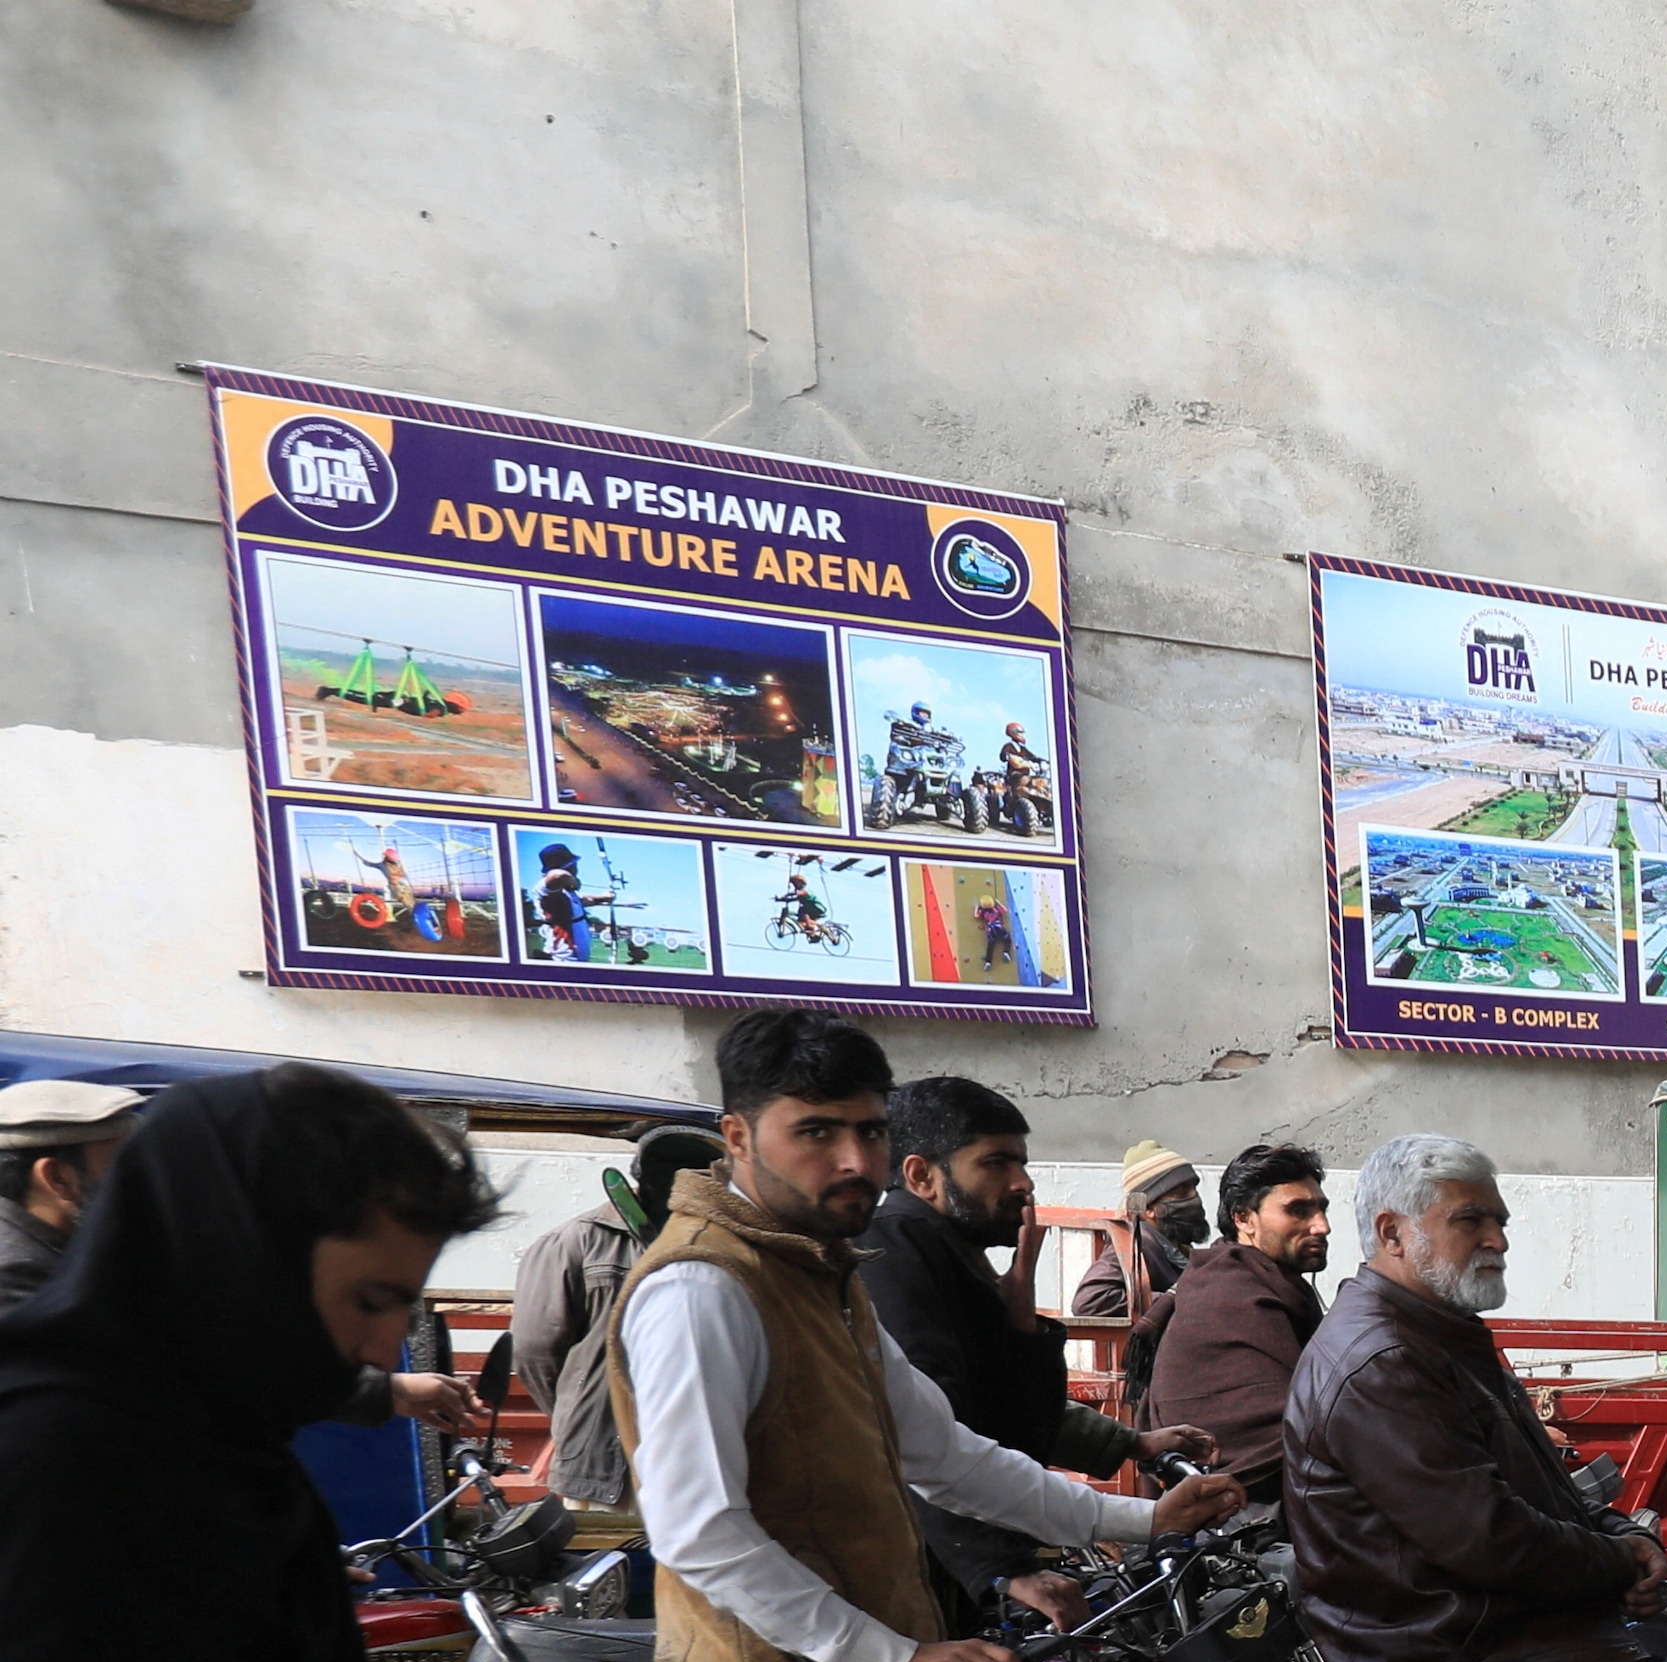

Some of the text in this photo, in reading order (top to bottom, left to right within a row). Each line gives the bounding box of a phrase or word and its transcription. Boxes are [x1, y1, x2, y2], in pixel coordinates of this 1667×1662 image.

[289, 454, 377, 505] DHA
[493, 458, 846, 543] DHA PESHAWAR
[429, 499, 912, 602] ADVENTURE ARENA
[1467, 644, 1536, 693] DHA
[1589, 659, 1638, 686] DHA
[1468, 687, 1538, 704] BUILDING DREAMS
[1398, 1000, 1476, 1024] SECTOR
[1494, 1006, 1507, 1024] B
[1514, 1007, 1600, 1030] COMPLEX
